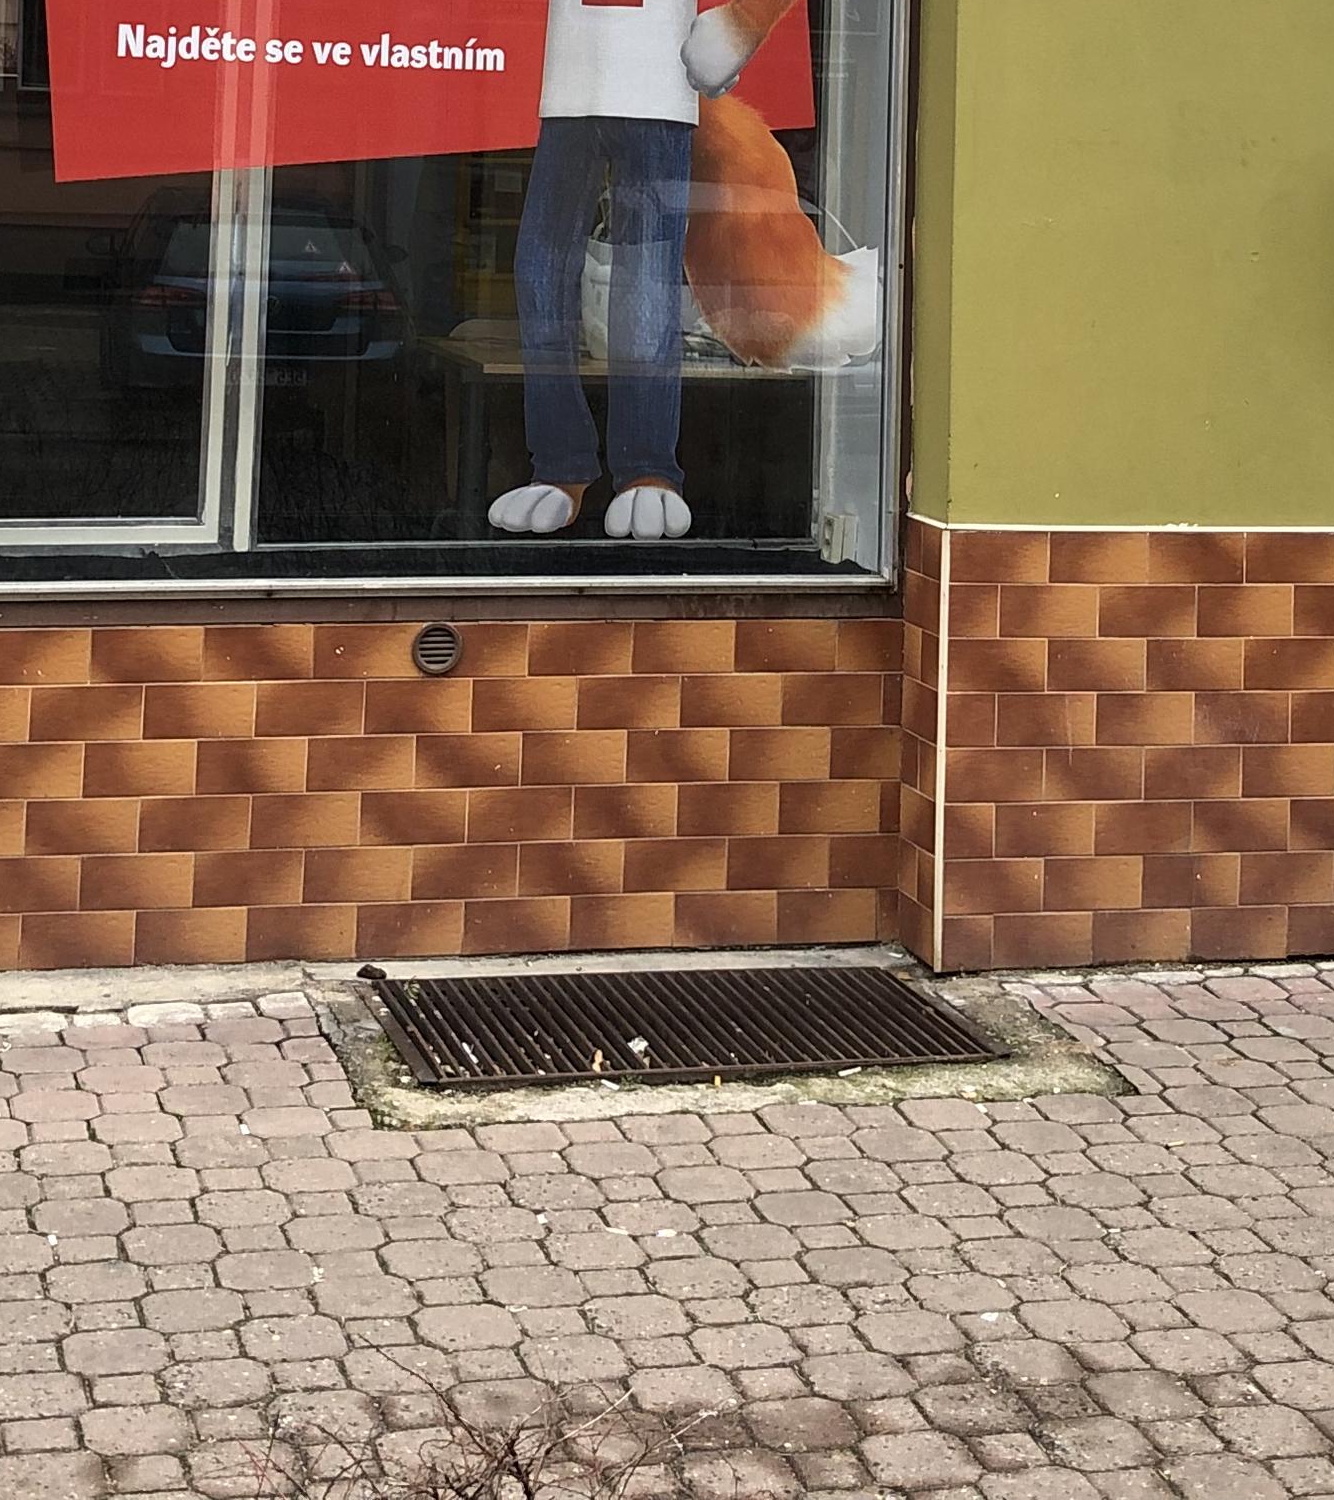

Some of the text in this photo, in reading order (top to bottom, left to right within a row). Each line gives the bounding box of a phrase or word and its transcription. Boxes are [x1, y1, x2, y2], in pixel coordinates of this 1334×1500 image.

[117, 23, 505, 71] Najděte se ve vlastním
